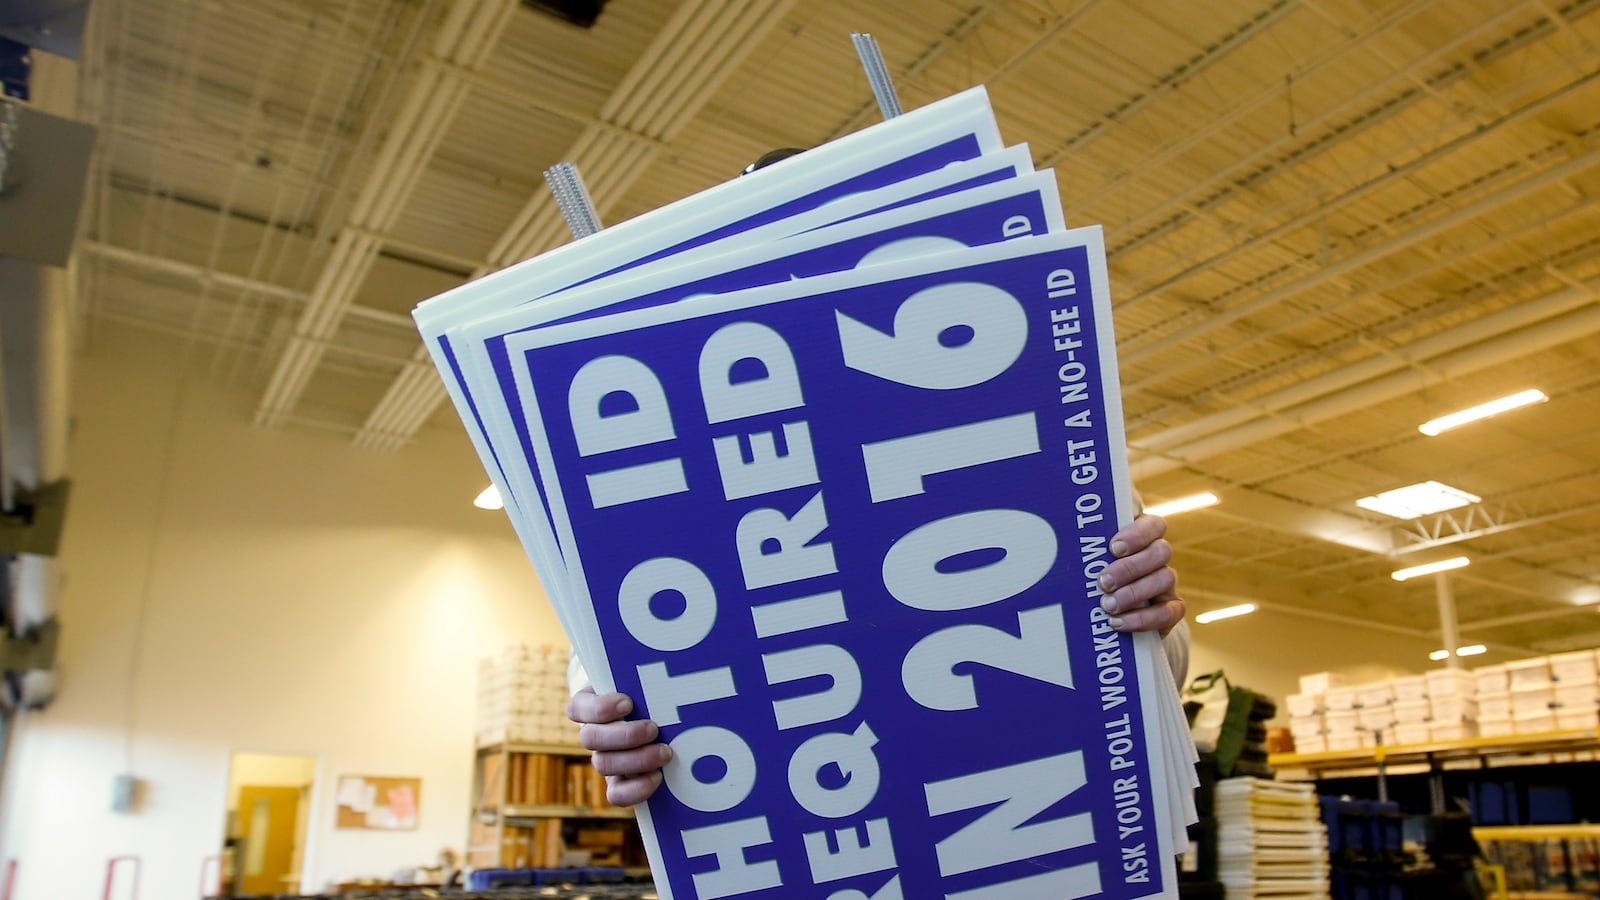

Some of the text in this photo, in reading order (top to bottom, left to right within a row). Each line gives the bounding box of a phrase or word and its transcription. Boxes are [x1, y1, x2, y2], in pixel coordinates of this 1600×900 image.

[1047, 268, 1076, 299] ID
[1051, 306, 1088, 404] NO-FEE
[1065, 409, 1092, 428] A
[1067, 440, 1098, 484] GET
[835, 282, 1075, 710] 2016
[1075, 494, 1103, 529] TO
[1080, 536, 1109, 598] HOW
[568, 355, 783, 900] HOTO ID
[1105, 714, 1134, 771] POLL
[924, 750, 1102, 900] IN
[1114, 775, 1143, 839] YOUR
[1122, 843, 1149, 882] ASK
